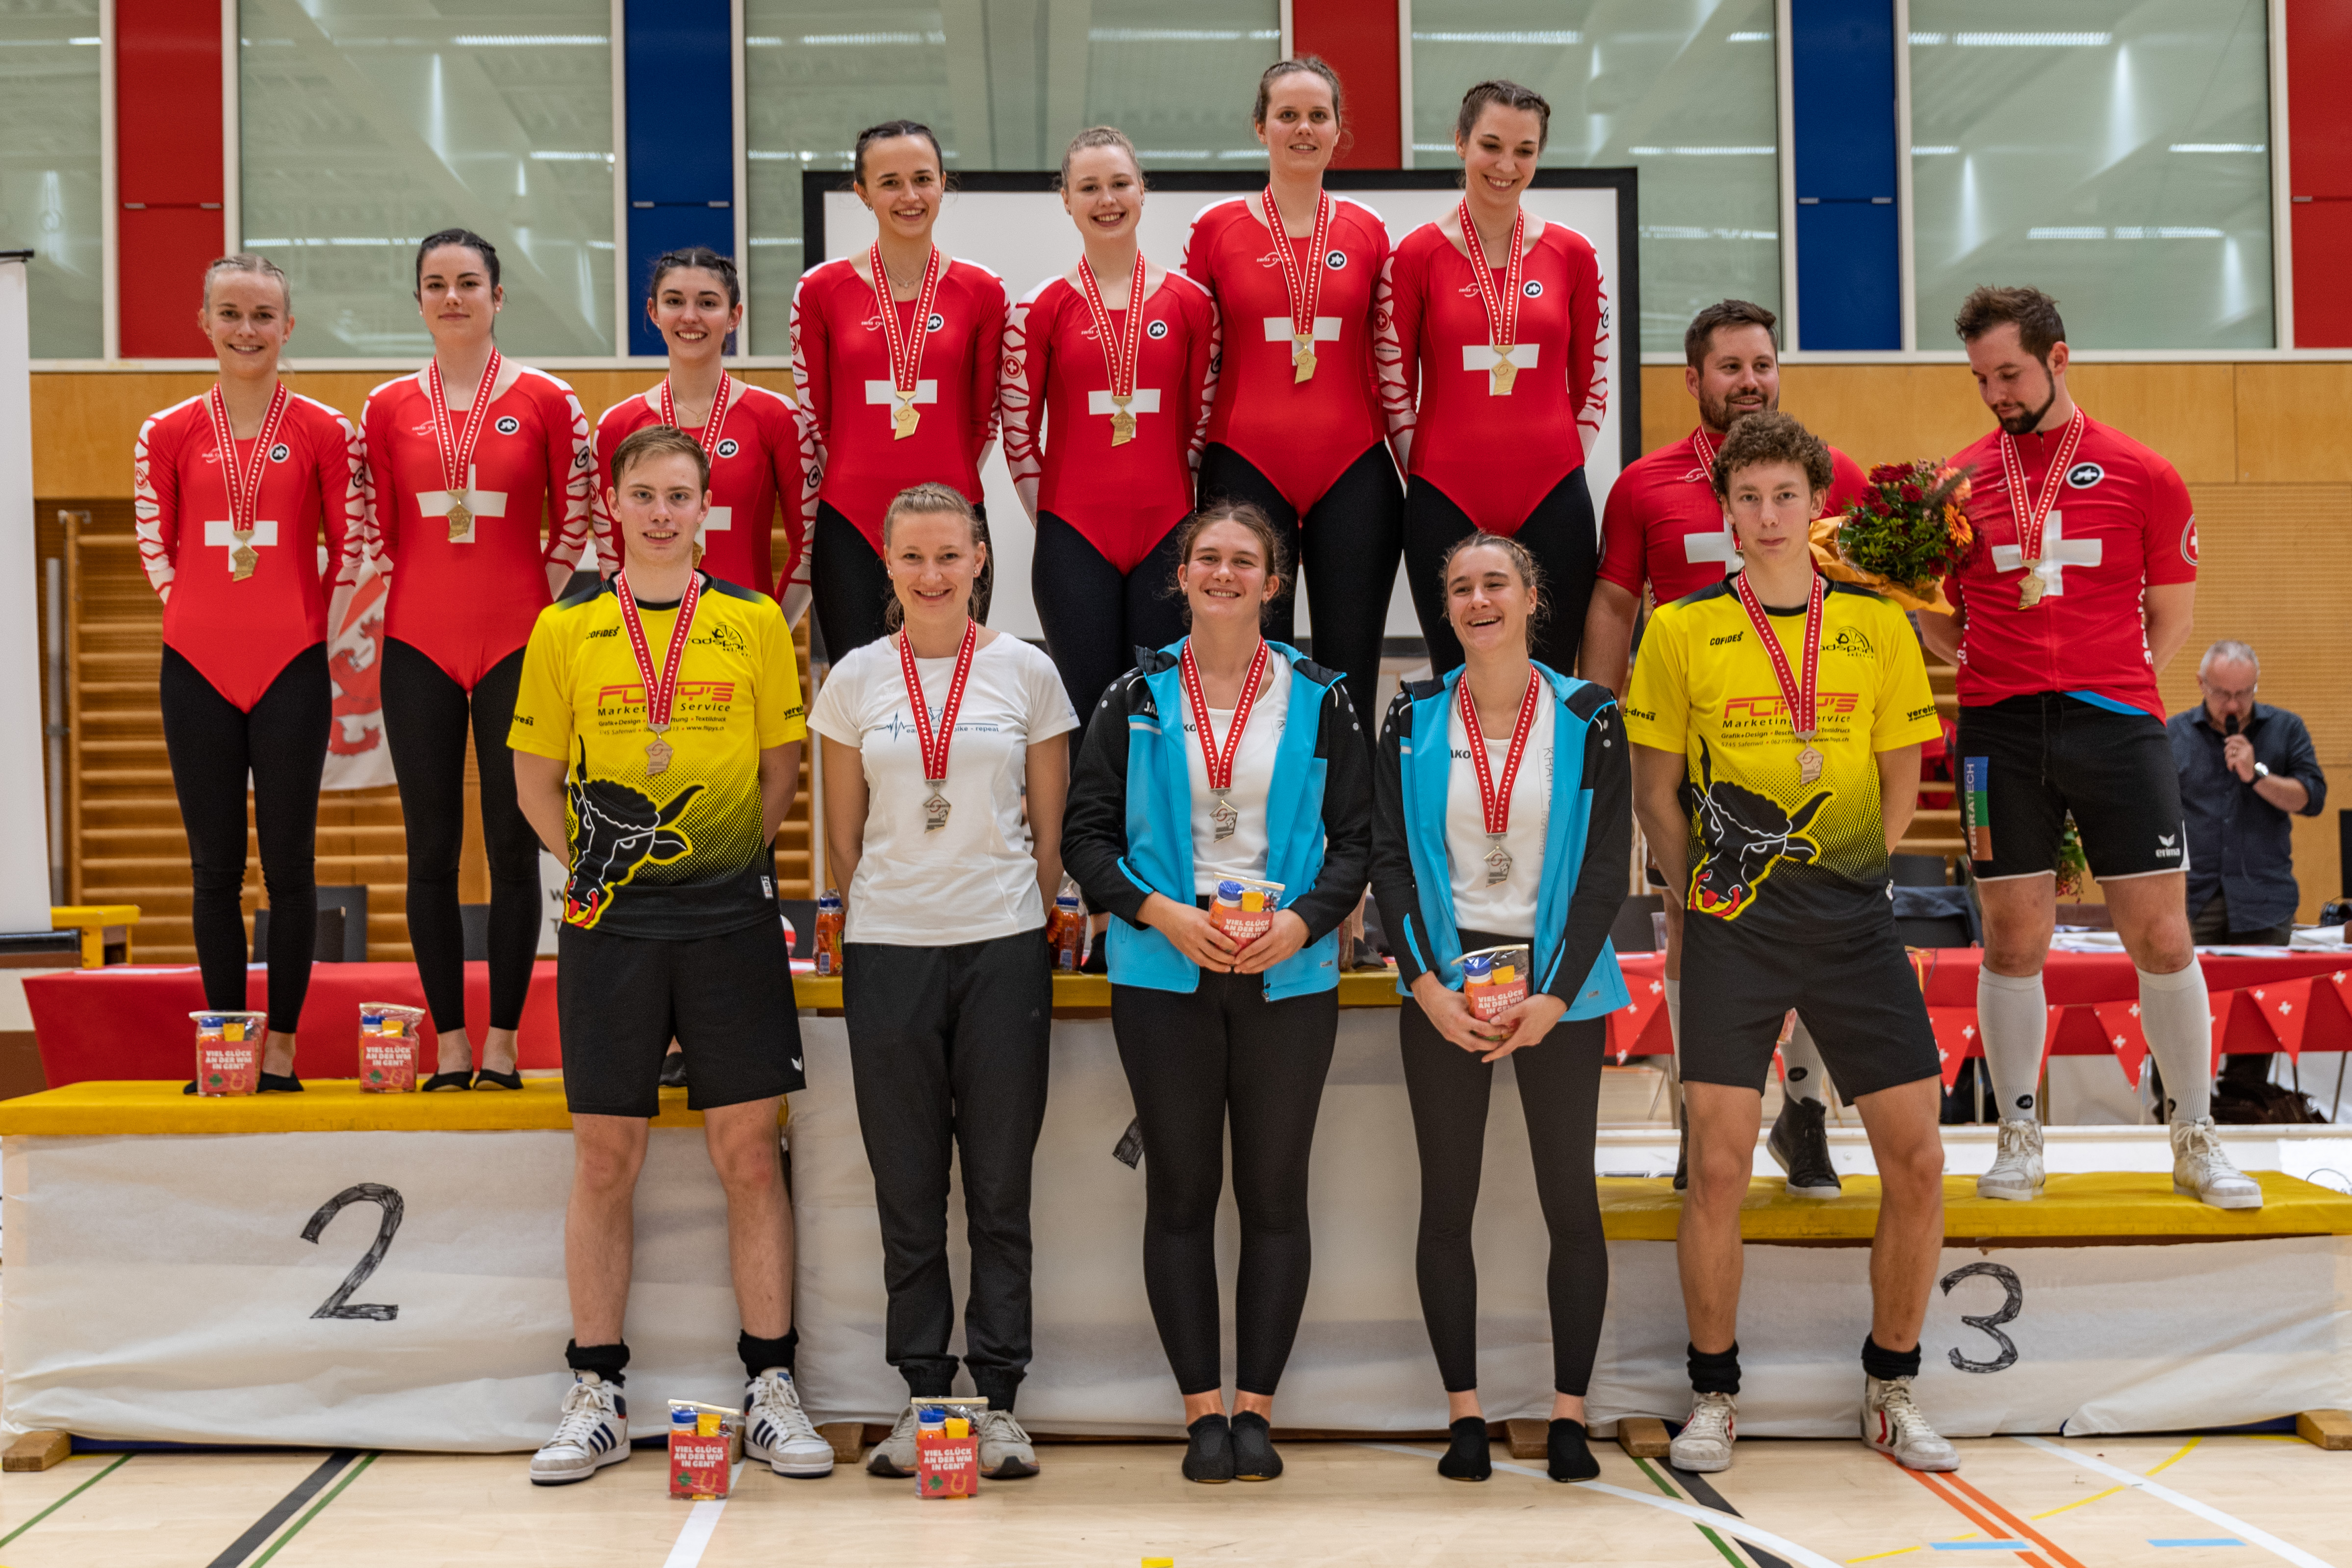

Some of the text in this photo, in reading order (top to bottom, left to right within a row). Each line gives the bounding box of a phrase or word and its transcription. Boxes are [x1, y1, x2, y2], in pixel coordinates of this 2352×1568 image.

[1820, 644, 1874, 653] adsport
[598, 703, 730, 716] Market Service
[1144, 701, 1158, 716] JA
[1183, 723, 1196, 732] KO
[1967, 764, 1977, 856] TERRATECH
[2155, 848, 2180, 858] erima
[1498, 989, 1524, 1000] GLÜCK
[1492, 999, 1508, 1008] DER
[1509, 995, 1524, 1004] WM
[225, 1048, 252, 1056] GLÜCK
[300, 1182, 405, 1321] 2
[1940, 1262, 2022, 1373] 3
[694, 1444, 723, 1453] GLÜCK
[944, 1446, 972, 1456] GLÜCK
[943, 1462, 966, 1470] GENT
